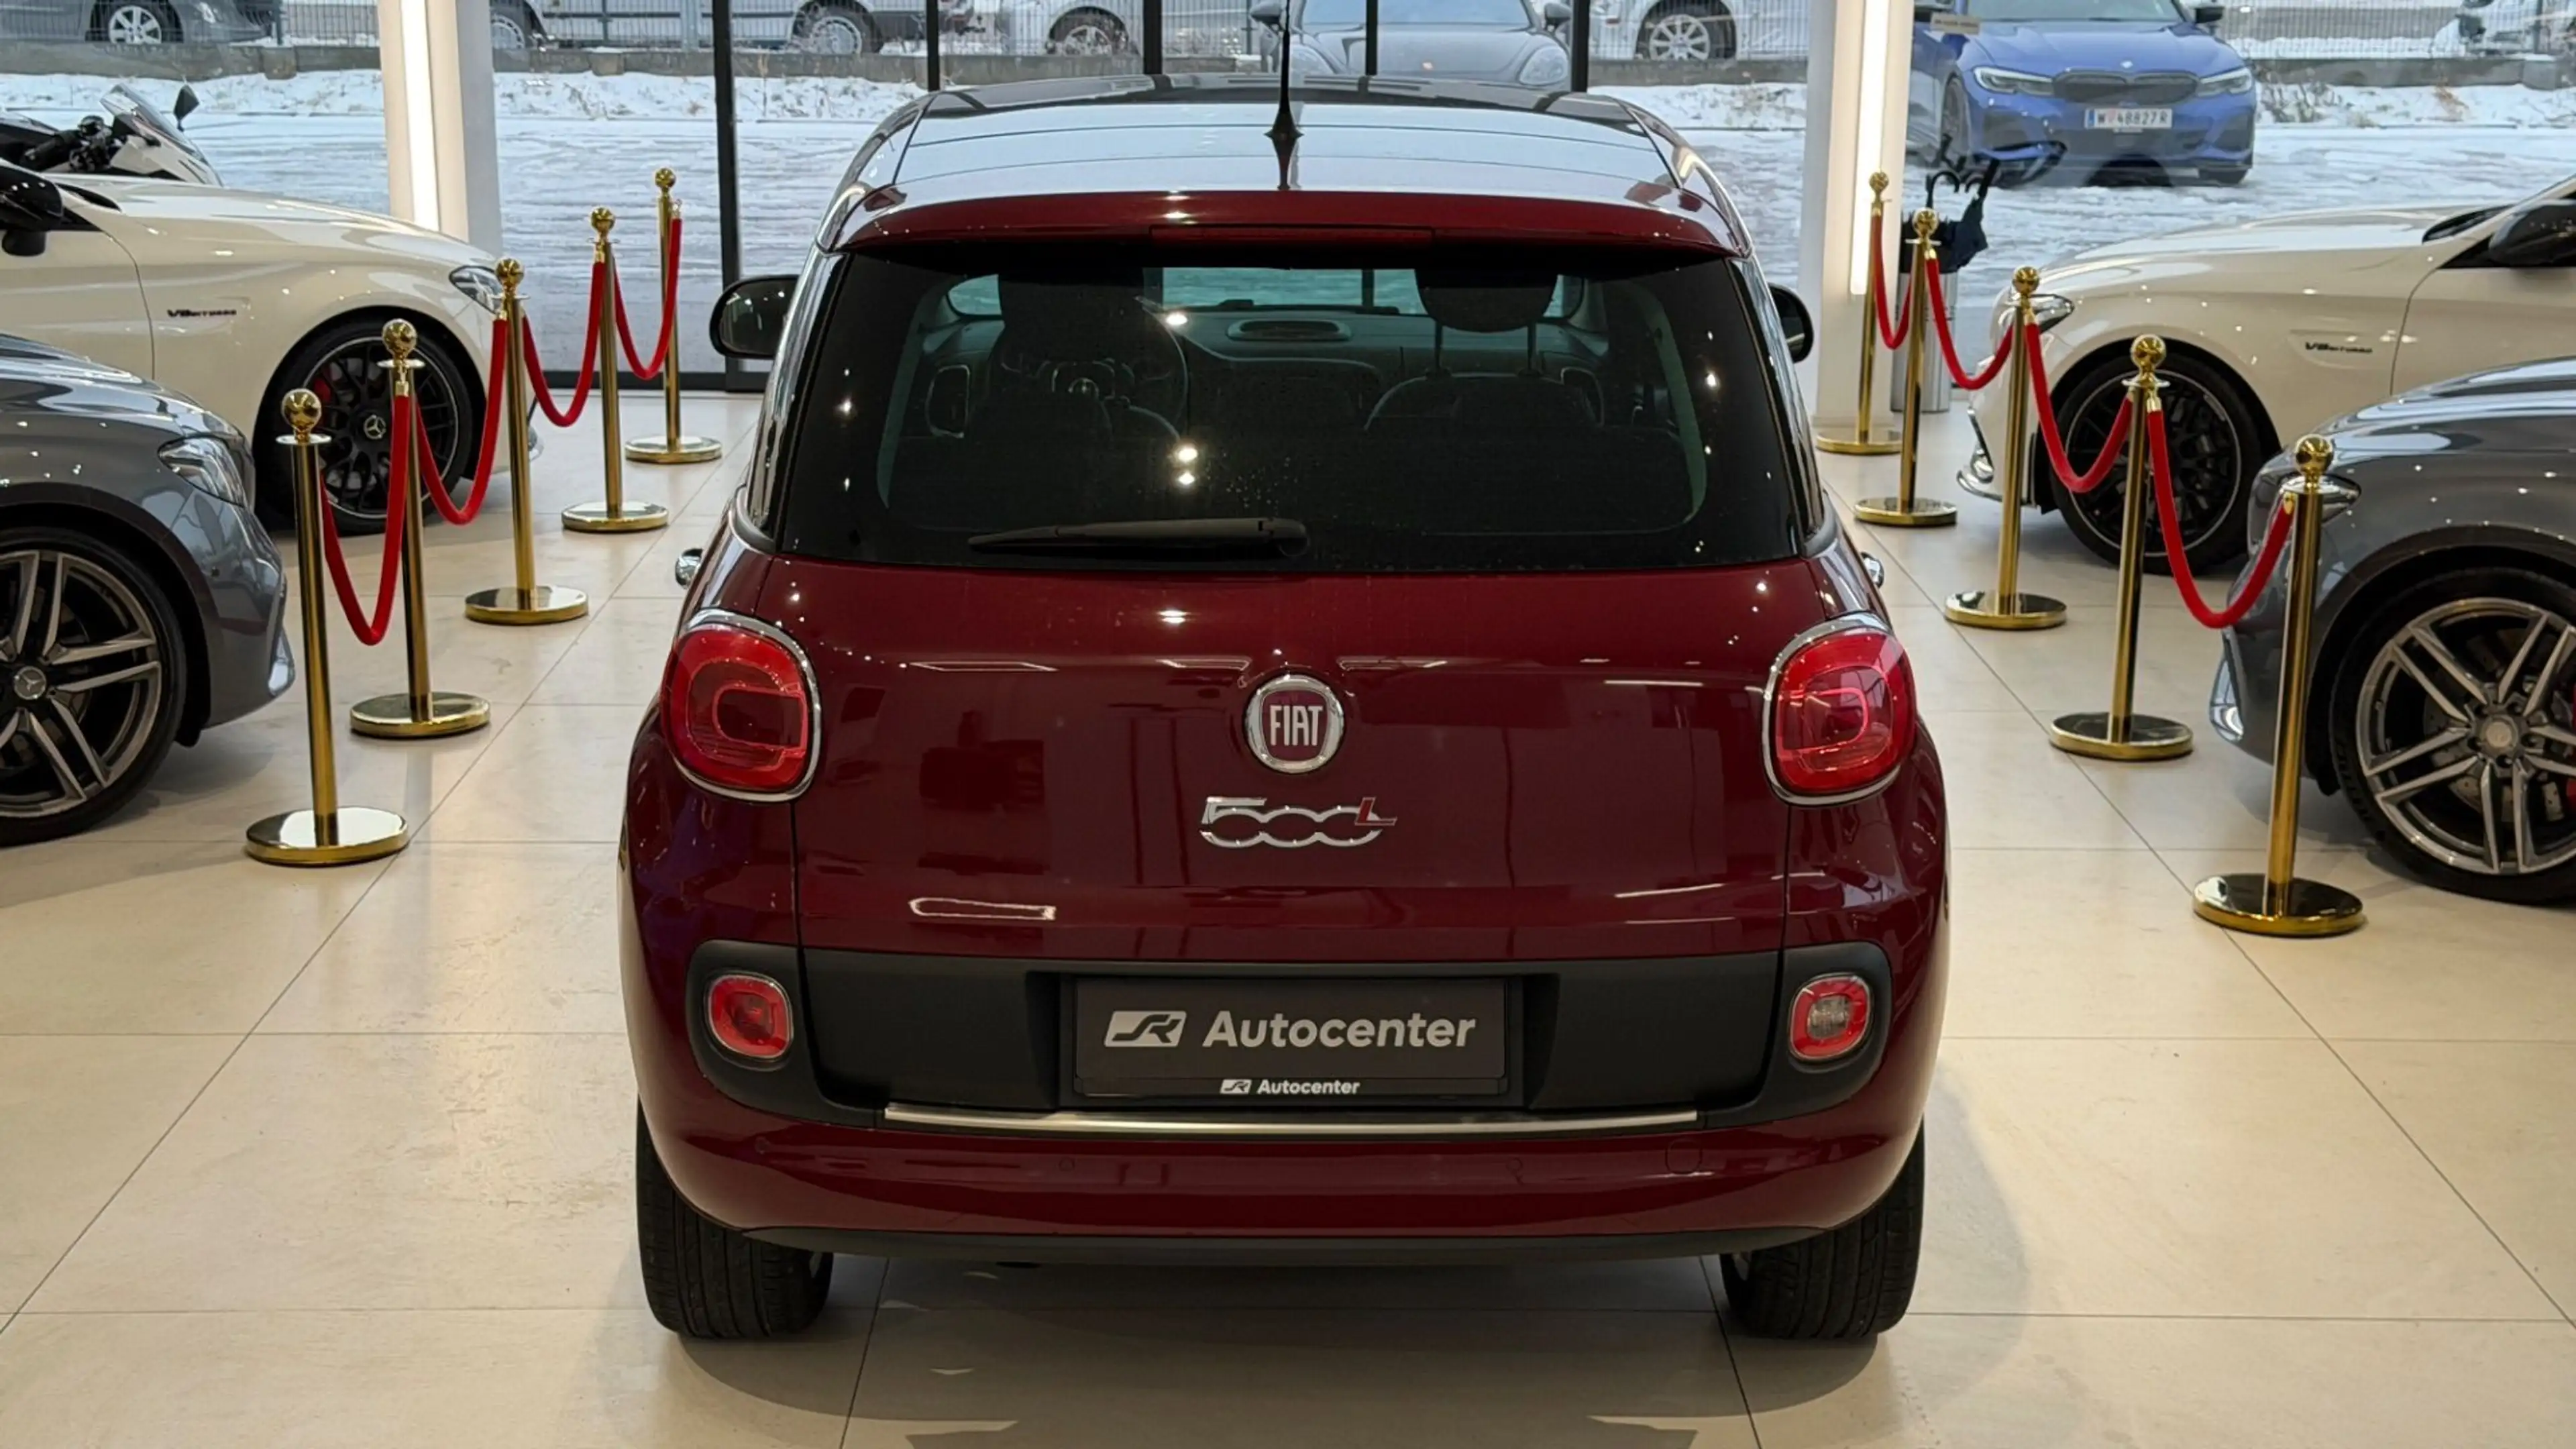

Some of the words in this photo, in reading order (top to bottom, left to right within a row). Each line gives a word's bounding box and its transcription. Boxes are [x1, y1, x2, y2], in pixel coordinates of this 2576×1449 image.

[1270, 705, 1323, 746] FIAT
[1202, 1010, 1476, 1047] Autocenter
[1256, 1079, 1360, 1094] Autocenter
